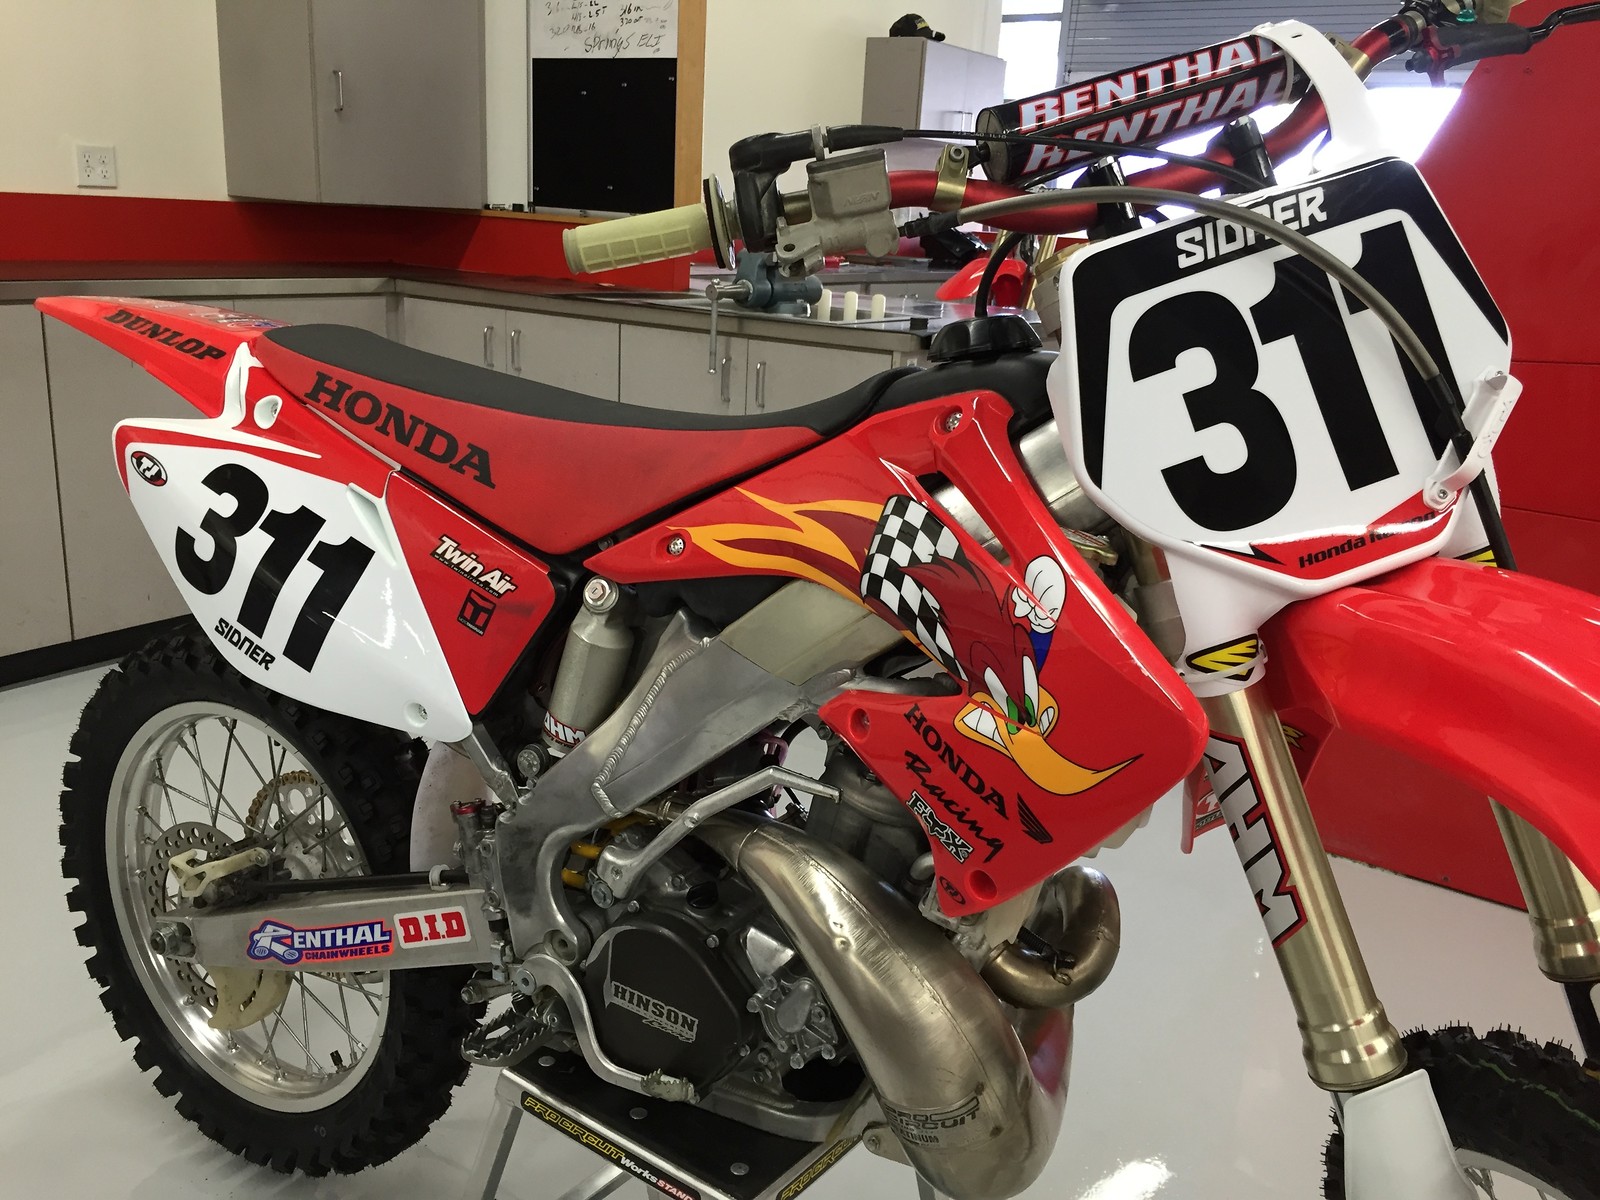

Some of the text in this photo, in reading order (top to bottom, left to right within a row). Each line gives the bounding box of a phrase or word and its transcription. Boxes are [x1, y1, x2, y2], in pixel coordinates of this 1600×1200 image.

[1019, 36, 1283, 134] RENTHAL
[1022, 69, 1288, 175] RENTHAL
[103, 309, 227, 360] DUNLOP
[1128, 219, 1466, 533] 311
[303, 371, 497, 489] HONDA
[175, 463, 376, 673] 311
[435, 535, 517, 595] Twin Air
[1298, 537, 1367, 568] Honda
[214, 617, 276, 672] SIDNER
[903, 703, 1009, 820] HONDA
[904, 750, 1005, 864] Racing
[253, 923, 390, 962] RENTHAL
[304, 944, 390, 961] CHAINWHEELS
[398, 911, 468, 944] D.I.D
[613, 984, 697, 1033] HINSON
[524, 1096, 560, 1121] PRO
[558, 1117, 626, 1160] CIRCUIT
[620, 1156, 658, 1184] Works
